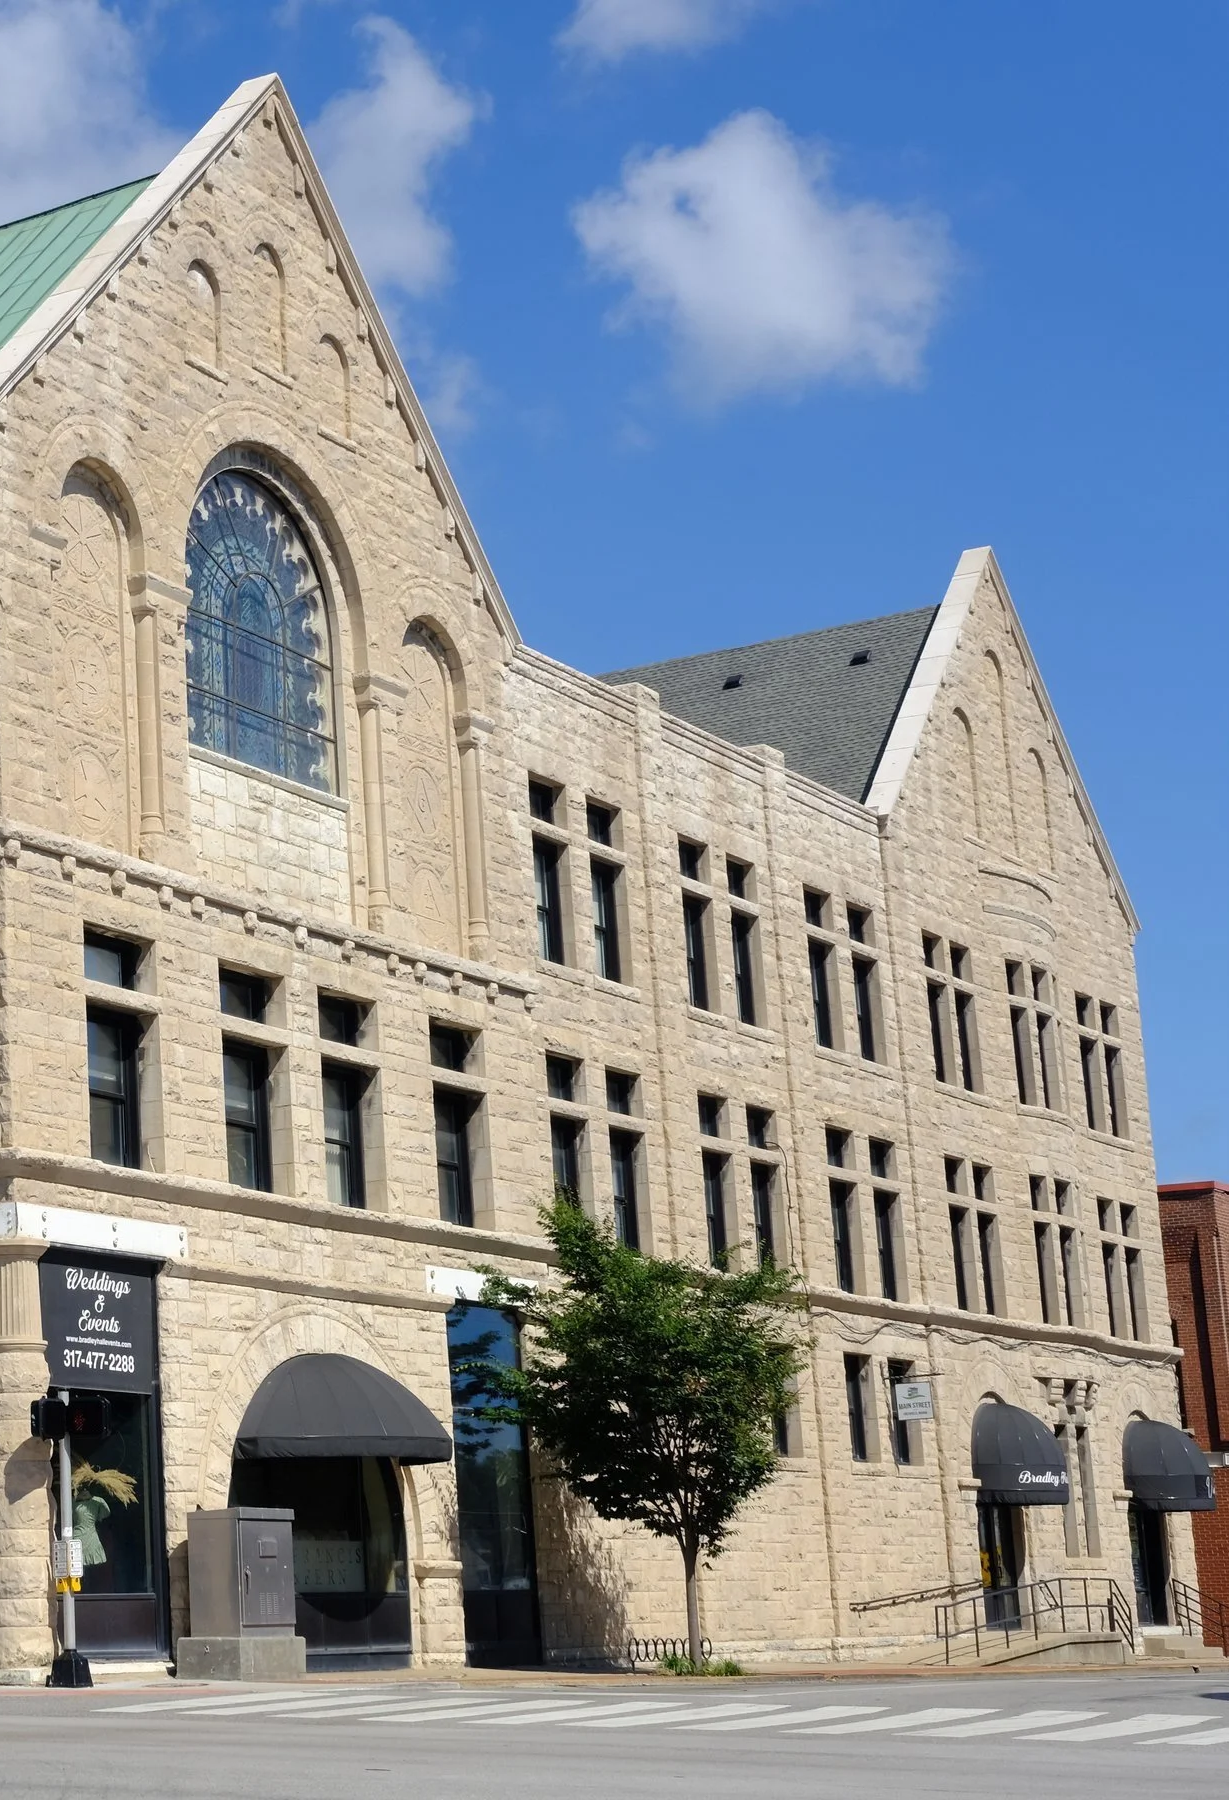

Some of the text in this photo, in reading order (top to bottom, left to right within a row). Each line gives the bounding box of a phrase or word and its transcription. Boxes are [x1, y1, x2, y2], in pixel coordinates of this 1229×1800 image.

[65, 1267, 131, 1299] Weddings
[94, 1293, 105, 1313] &
[78, 1309, 121, 1334] Events
[65, 1335, 132, 1349] www.bradleyhallevents.com
[63, 1348, 135, 1373] 317-477-2288
[912, 1401, 931, 1409] STREET
[1018, 1470, 1059, 1487] Bradley
